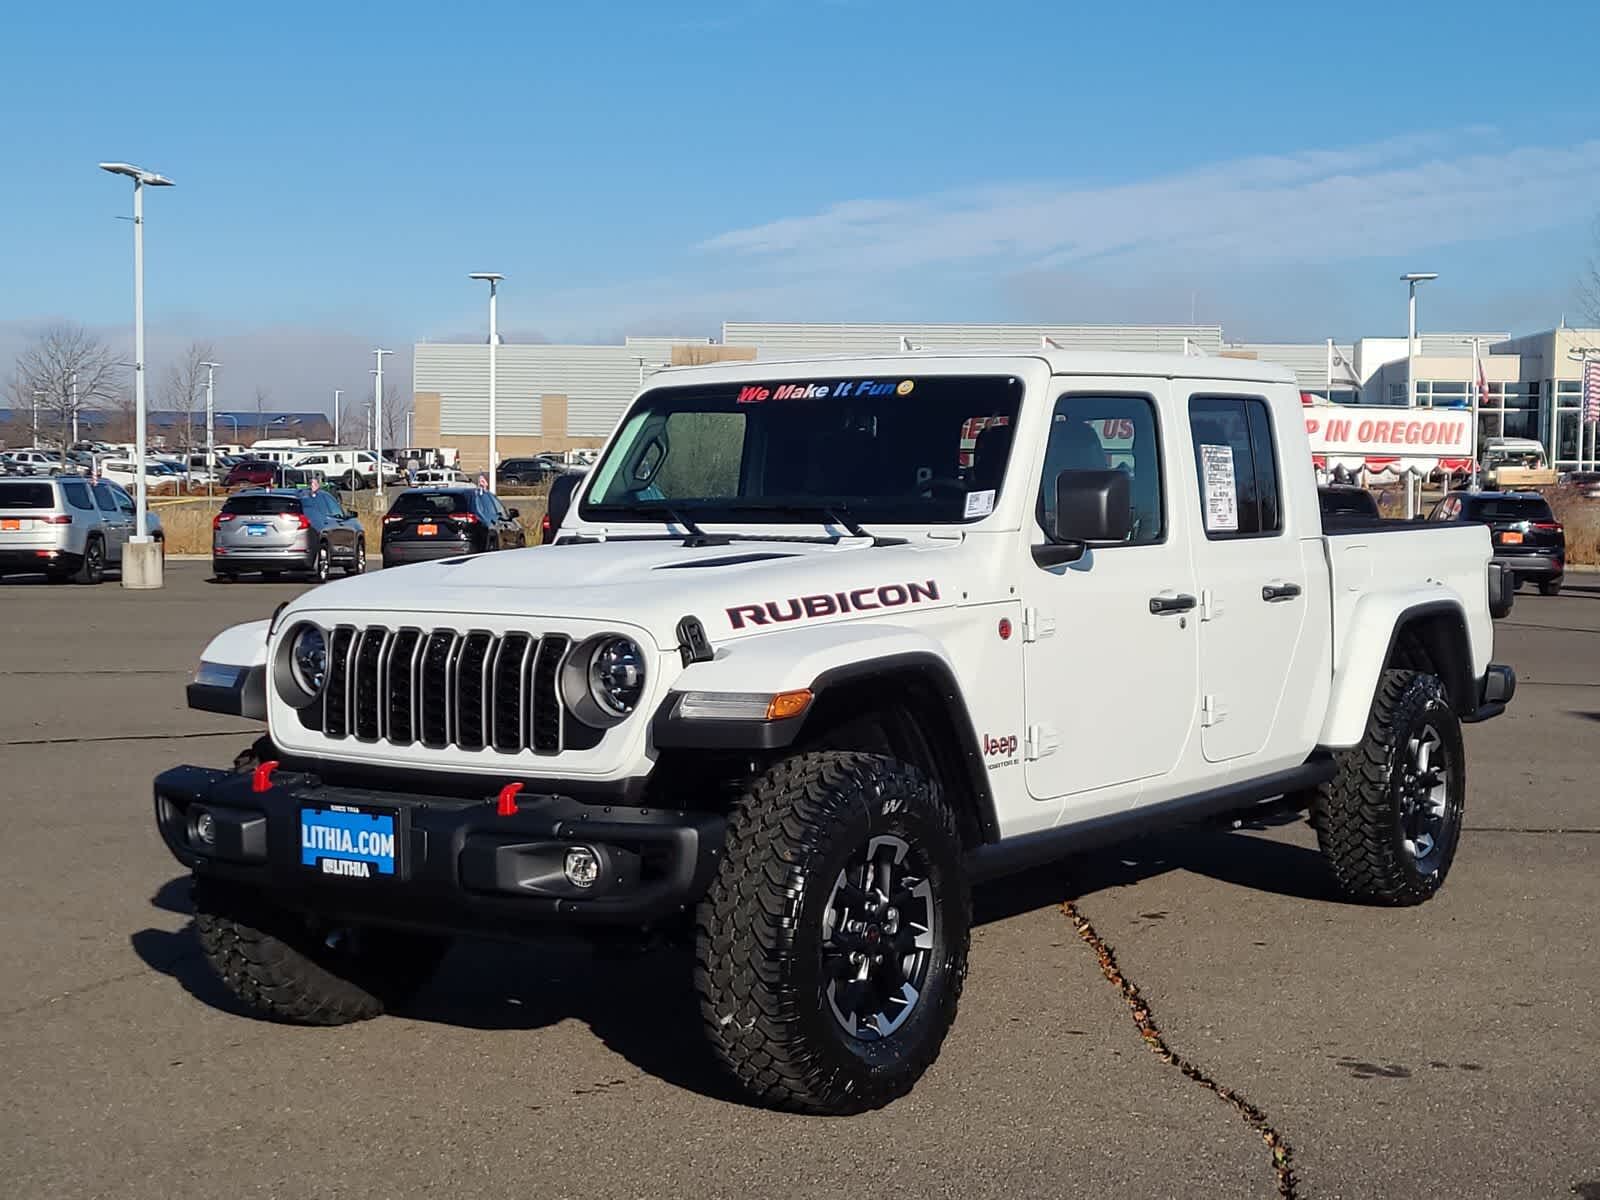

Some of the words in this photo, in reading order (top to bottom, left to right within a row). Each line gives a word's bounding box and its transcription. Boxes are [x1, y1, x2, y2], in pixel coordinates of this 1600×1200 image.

[737, 386, 770, 402] We
[773, 384, 830, 401] Make
[832, 382, 853, 397] It
[854, 381, 897, 396] Fun
[1102, 418, 1135, 440] US
[1325, 419, 1352, 443] IN
[1357, 420, 1465, 445] OREGON!
[726, 580, 940, 629] RUBICON
[984, 733, 1018, 758] Jeep
[302, 824, 394, 858] LITHIA.COM
[333, 859, 370, 878] LITHIA
